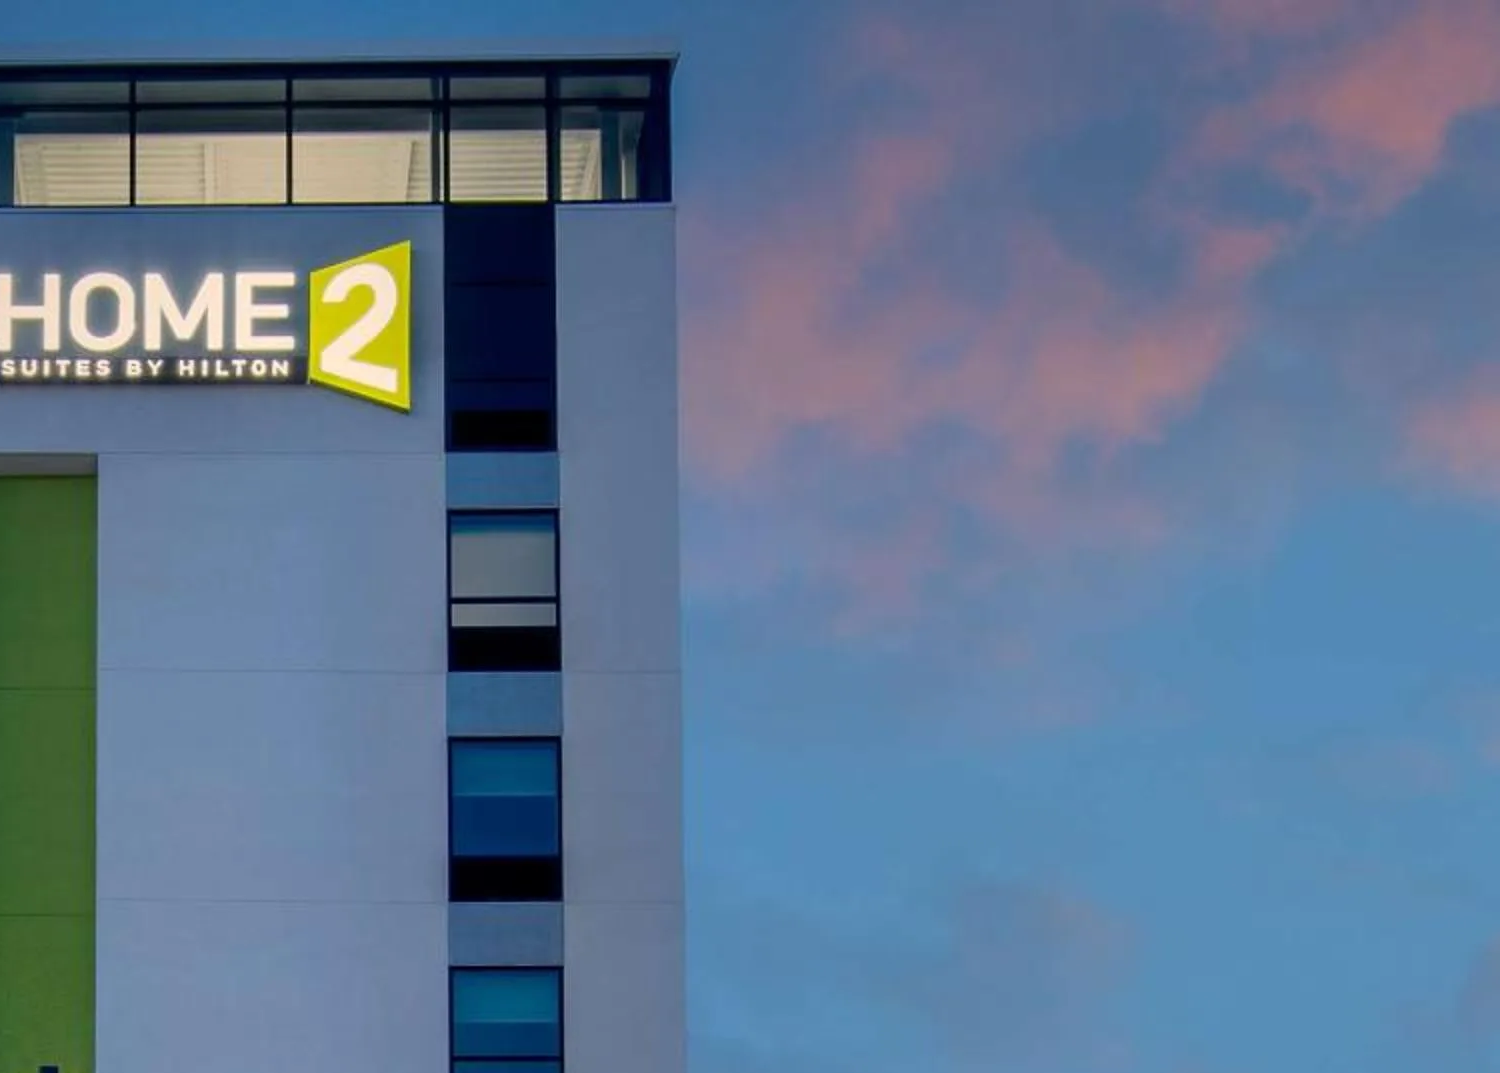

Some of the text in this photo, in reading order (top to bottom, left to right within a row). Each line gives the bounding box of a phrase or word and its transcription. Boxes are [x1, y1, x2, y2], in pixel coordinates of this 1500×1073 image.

[319, 262, 398, 394] 2
[0, 357, 290, 378] SUITES BY HILTON
